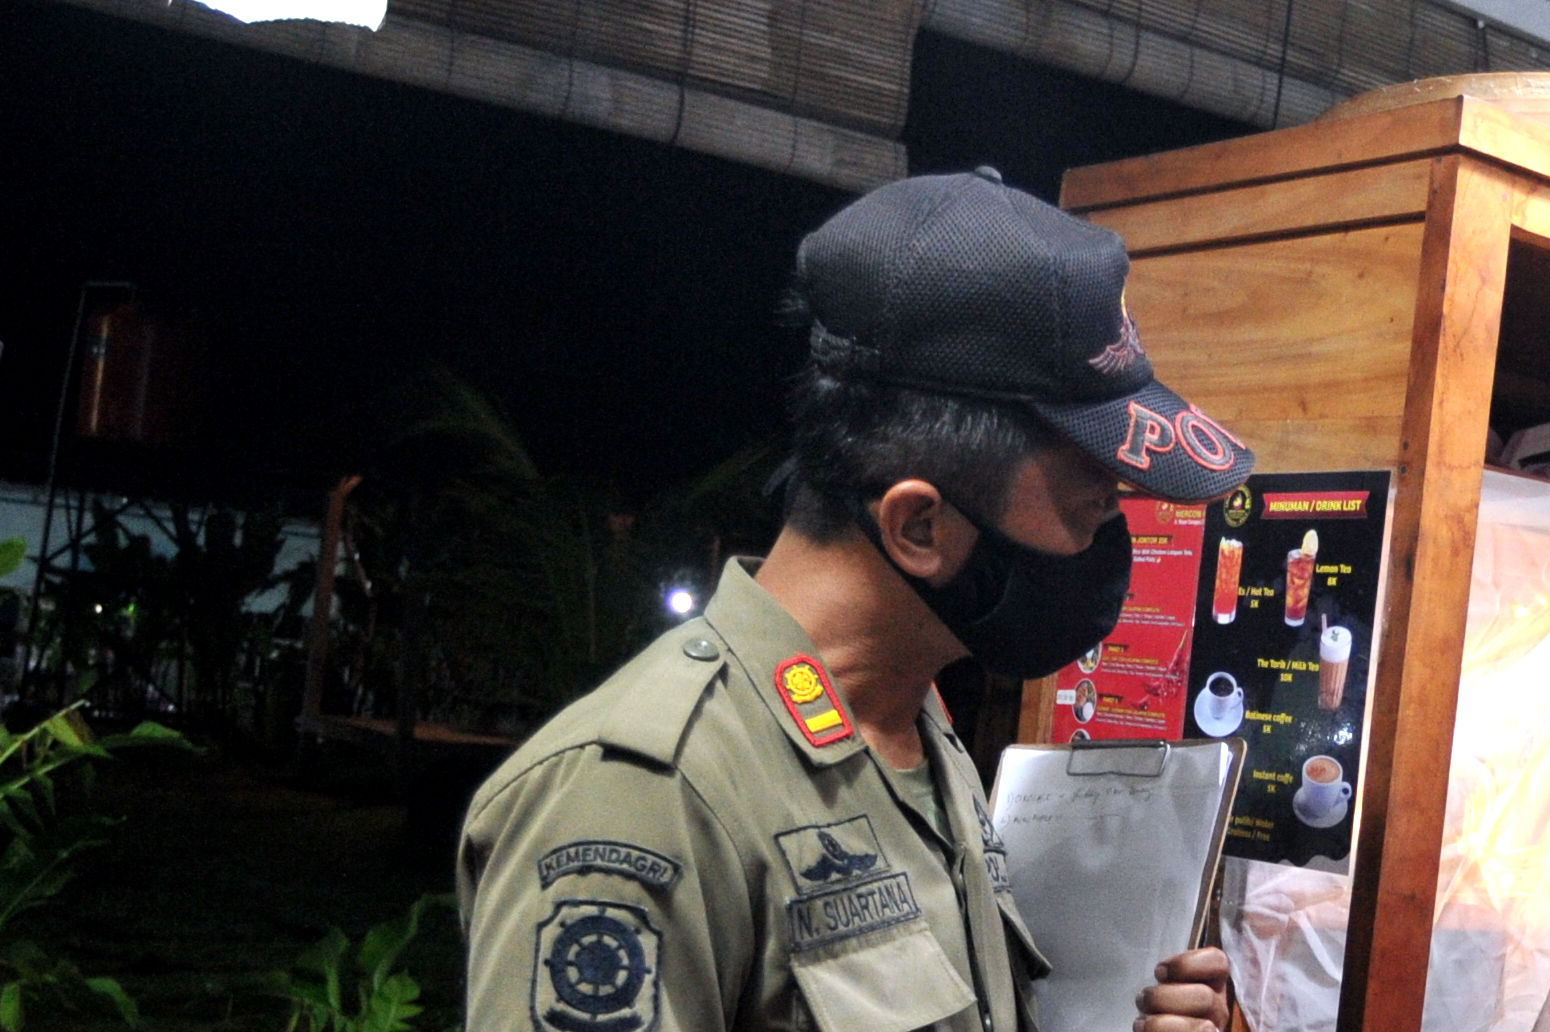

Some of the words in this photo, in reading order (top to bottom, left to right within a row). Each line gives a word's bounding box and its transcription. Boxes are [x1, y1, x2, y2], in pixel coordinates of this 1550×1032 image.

[1117, 400, 1247, 471] PO
[1269, 500, 1308, 512] MINUMAN
[1316, 500, 1342, 511] DRINK
[1343, 500, 1362, 511] LIST
[1315, 564, 1338, 574] Lemon
[1340, 564, 1352, 574] Tea
[1251, 587, 1263, 596] Hot
[1264, 587, 1275, 597] Tea
[1308, 662, 1320, 672] Tea
[543, 846, 669, 880] KEMENDAGRI
[823, 879, 913, 932] SUARTANA
